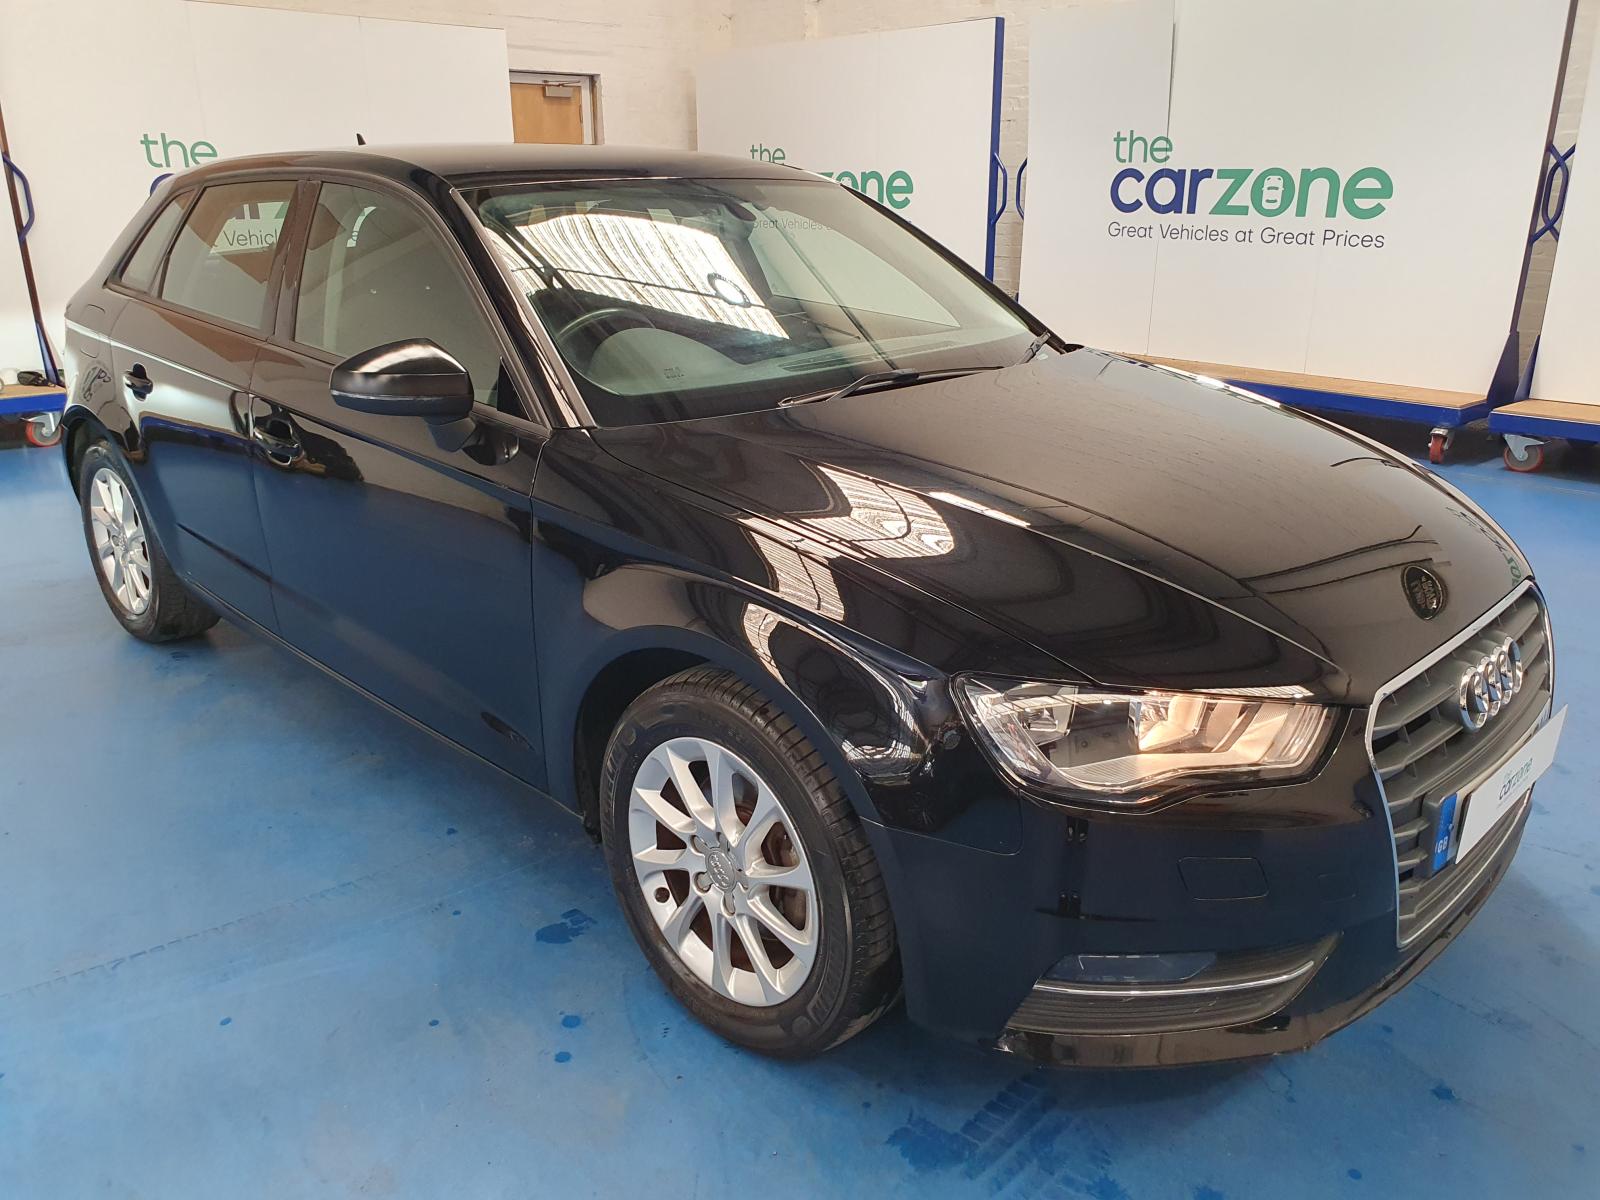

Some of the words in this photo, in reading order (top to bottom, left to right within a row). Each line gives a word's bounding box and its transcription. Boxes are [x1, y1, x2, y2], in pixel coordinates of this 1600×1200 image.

[140, 132, 218, 168] the
[750, 143, 786, 165] the
[1113, 129, 1174, 164] the
[223, 228, 278, 247] Vehicl
[1107, 221, 1153, 239] Great
[1159, 224, 1229, 242] Vehicles
[1235, 227, 1253, 243] at
[1260, 227, 1315, 246] Great
[1322, 229, 1385, 249] Prices
